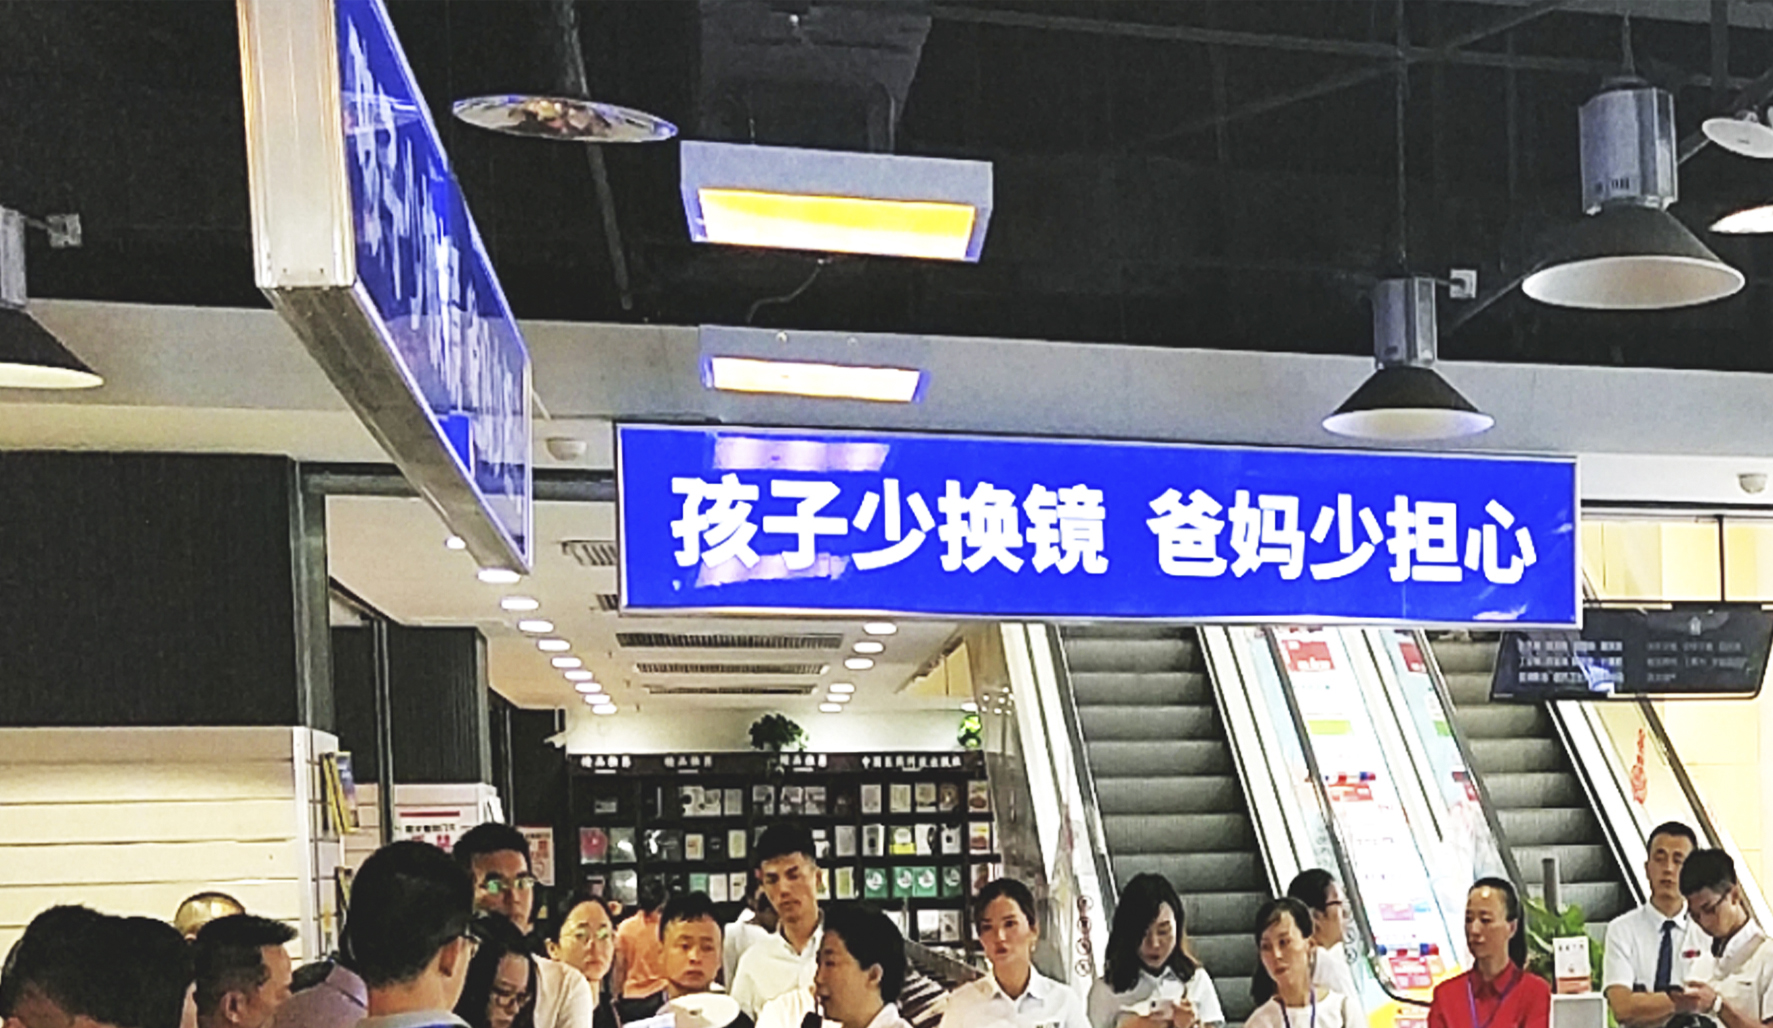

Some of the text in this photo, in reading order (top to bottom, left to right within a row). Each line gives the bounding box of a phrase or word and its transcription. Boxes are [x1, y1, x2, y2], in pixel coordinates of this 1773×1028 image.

[670, 473, 1537, 584] 孩子少换镜 爸妈少担心
